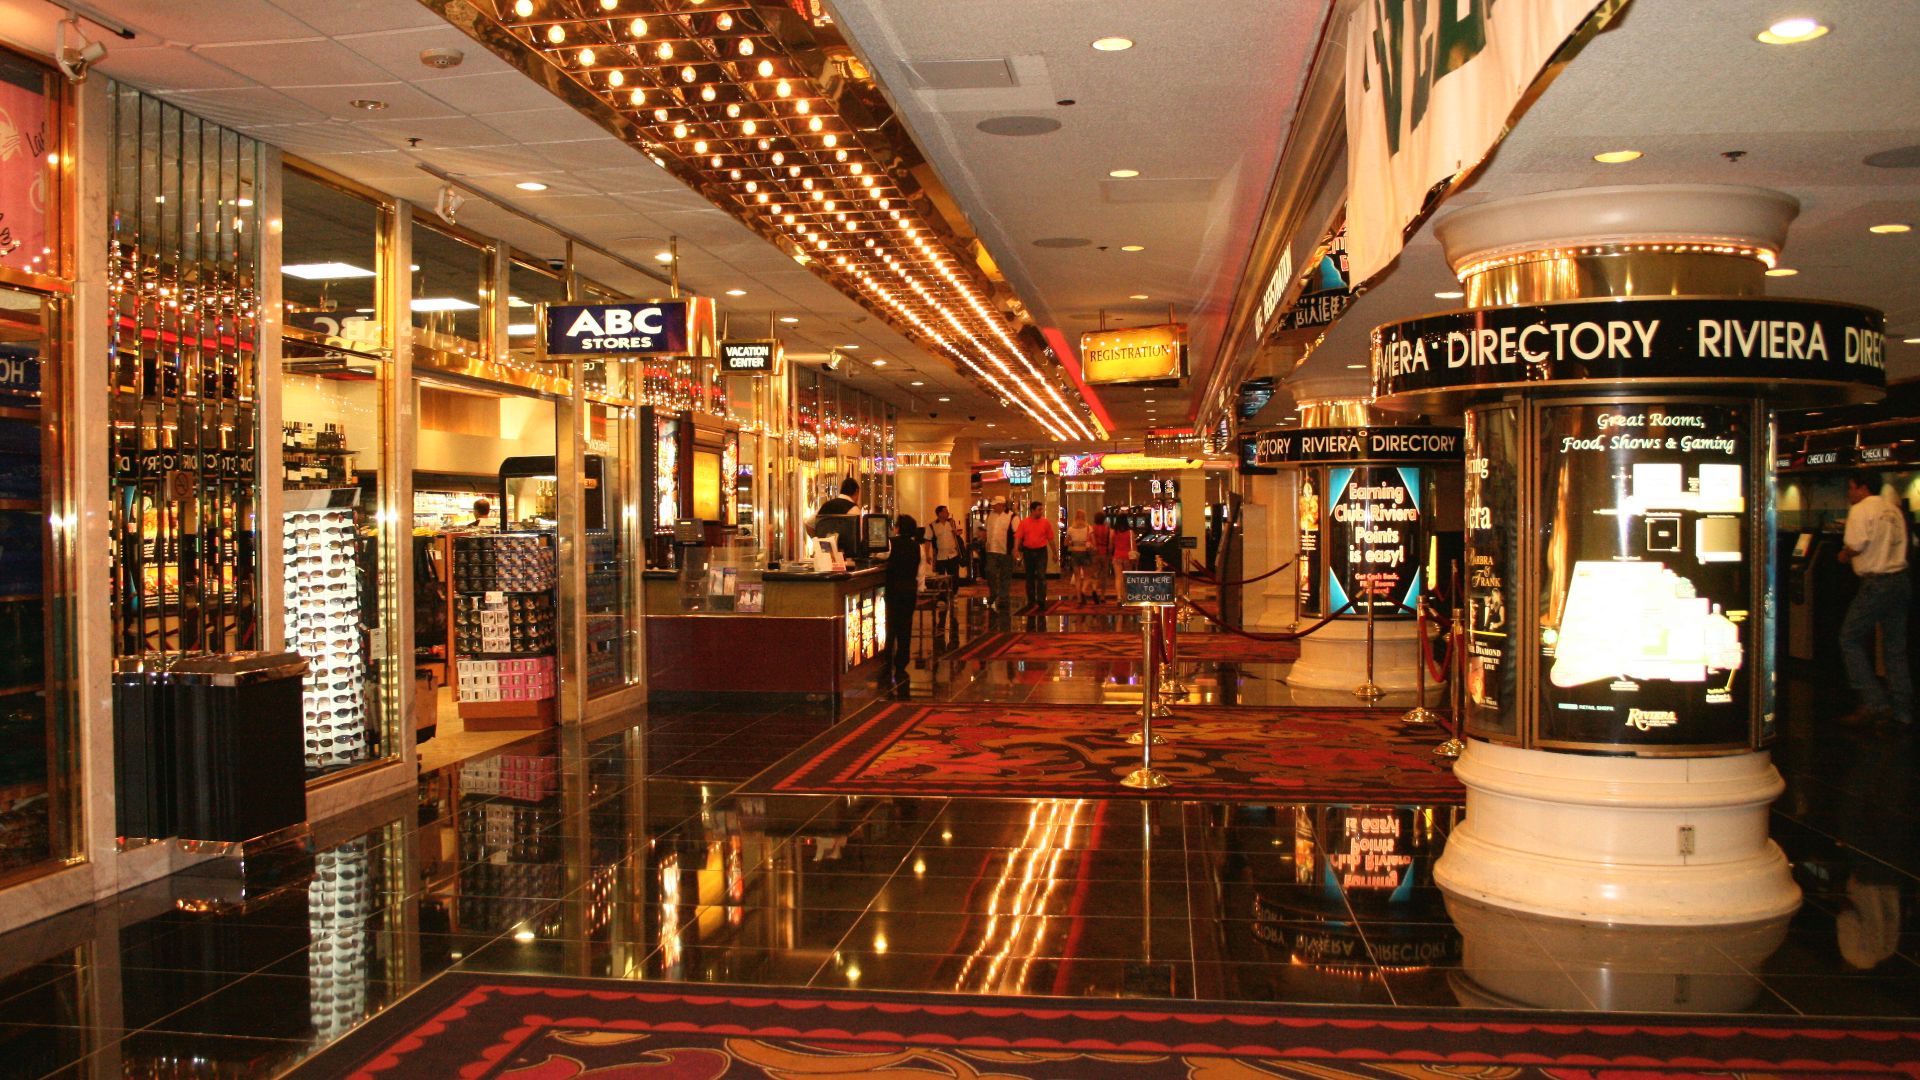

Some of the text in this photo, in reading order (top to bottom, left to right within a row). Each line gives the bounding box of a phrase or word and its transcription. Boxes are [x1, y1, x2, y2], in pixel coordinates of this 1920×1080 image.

[566, 308, 662, 337] ABC
[581, 337, 652, 350] STORES
[726, 346, 769, 357] VACATION
[1448, 320, 1661, 369] DIRECTORY
[1698, 319, 1829, 361] RIVIERA
[730, 357, 764, 368] CENTER
[1090, 344, 1169, 363] REGISTRATION
[1597, 413, 1706, 429] Great Rooms,
[1302, 436, 1361, 453] RIVIERA
[1373, 434, 1456, 452] DIRECTORY
[1560, 434, 1735, 454] Food, Shows & Gaming
[1862, 448, 1890, 459] CHECK IN
[1349, 482, 1404, 504] Earning
[1334, 503, 1417, 521] Club Riviera
[1355, 527, 1399, 544] Points
[1349, 545, 1404, 567] is easy!
[1625, 708, 1678, 731] RIVIERA
